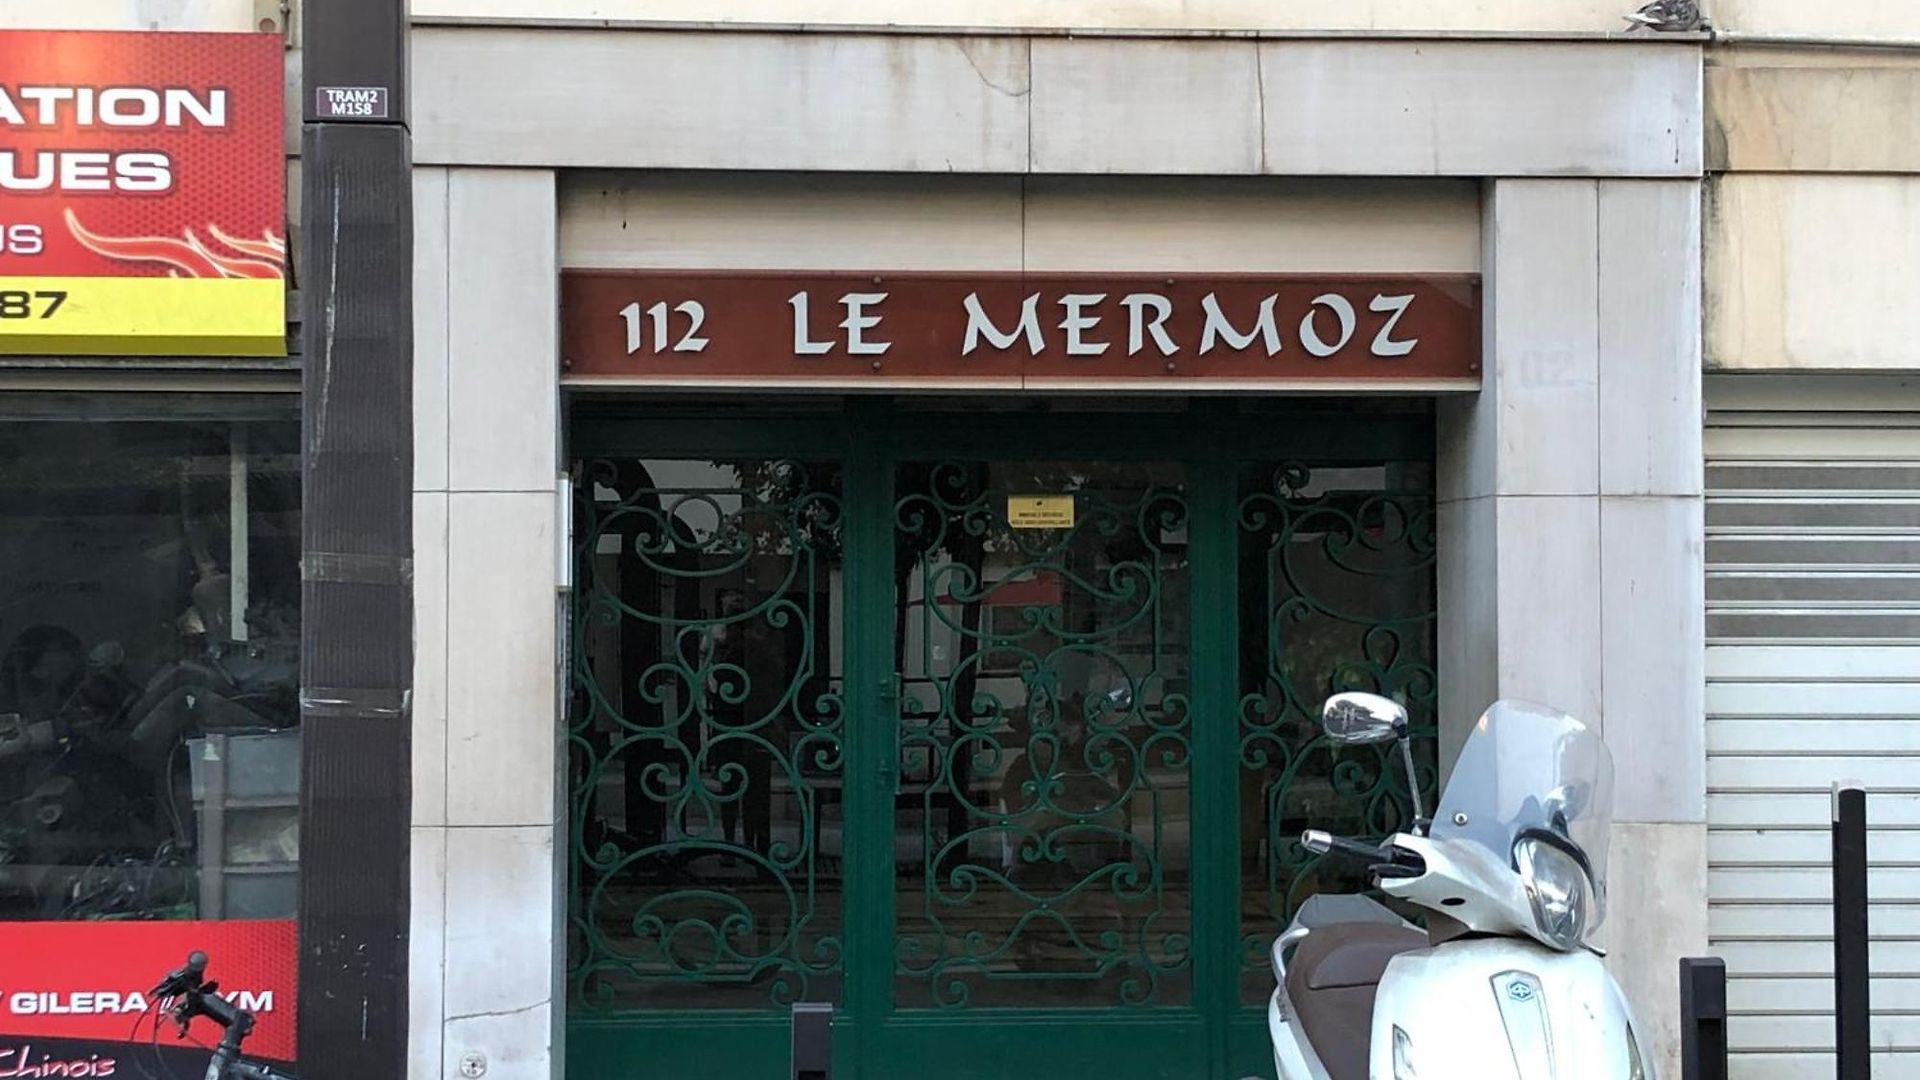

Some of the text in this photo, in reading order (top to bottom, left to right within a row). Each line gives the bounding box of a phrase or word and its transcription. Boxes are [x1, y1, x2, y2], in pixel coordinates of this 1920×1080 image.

[326, 90, 378, 103] TRAM2
[332, 102, 373, 115] M158
[0, 152, 172, 190] UES
[0, 224, 43, 254] S
[0, 290, 68, 319] 87
[619, 291, 1418, 357] 112 LE MERMOZ
[10, 992, 148, 1014] GILERA
